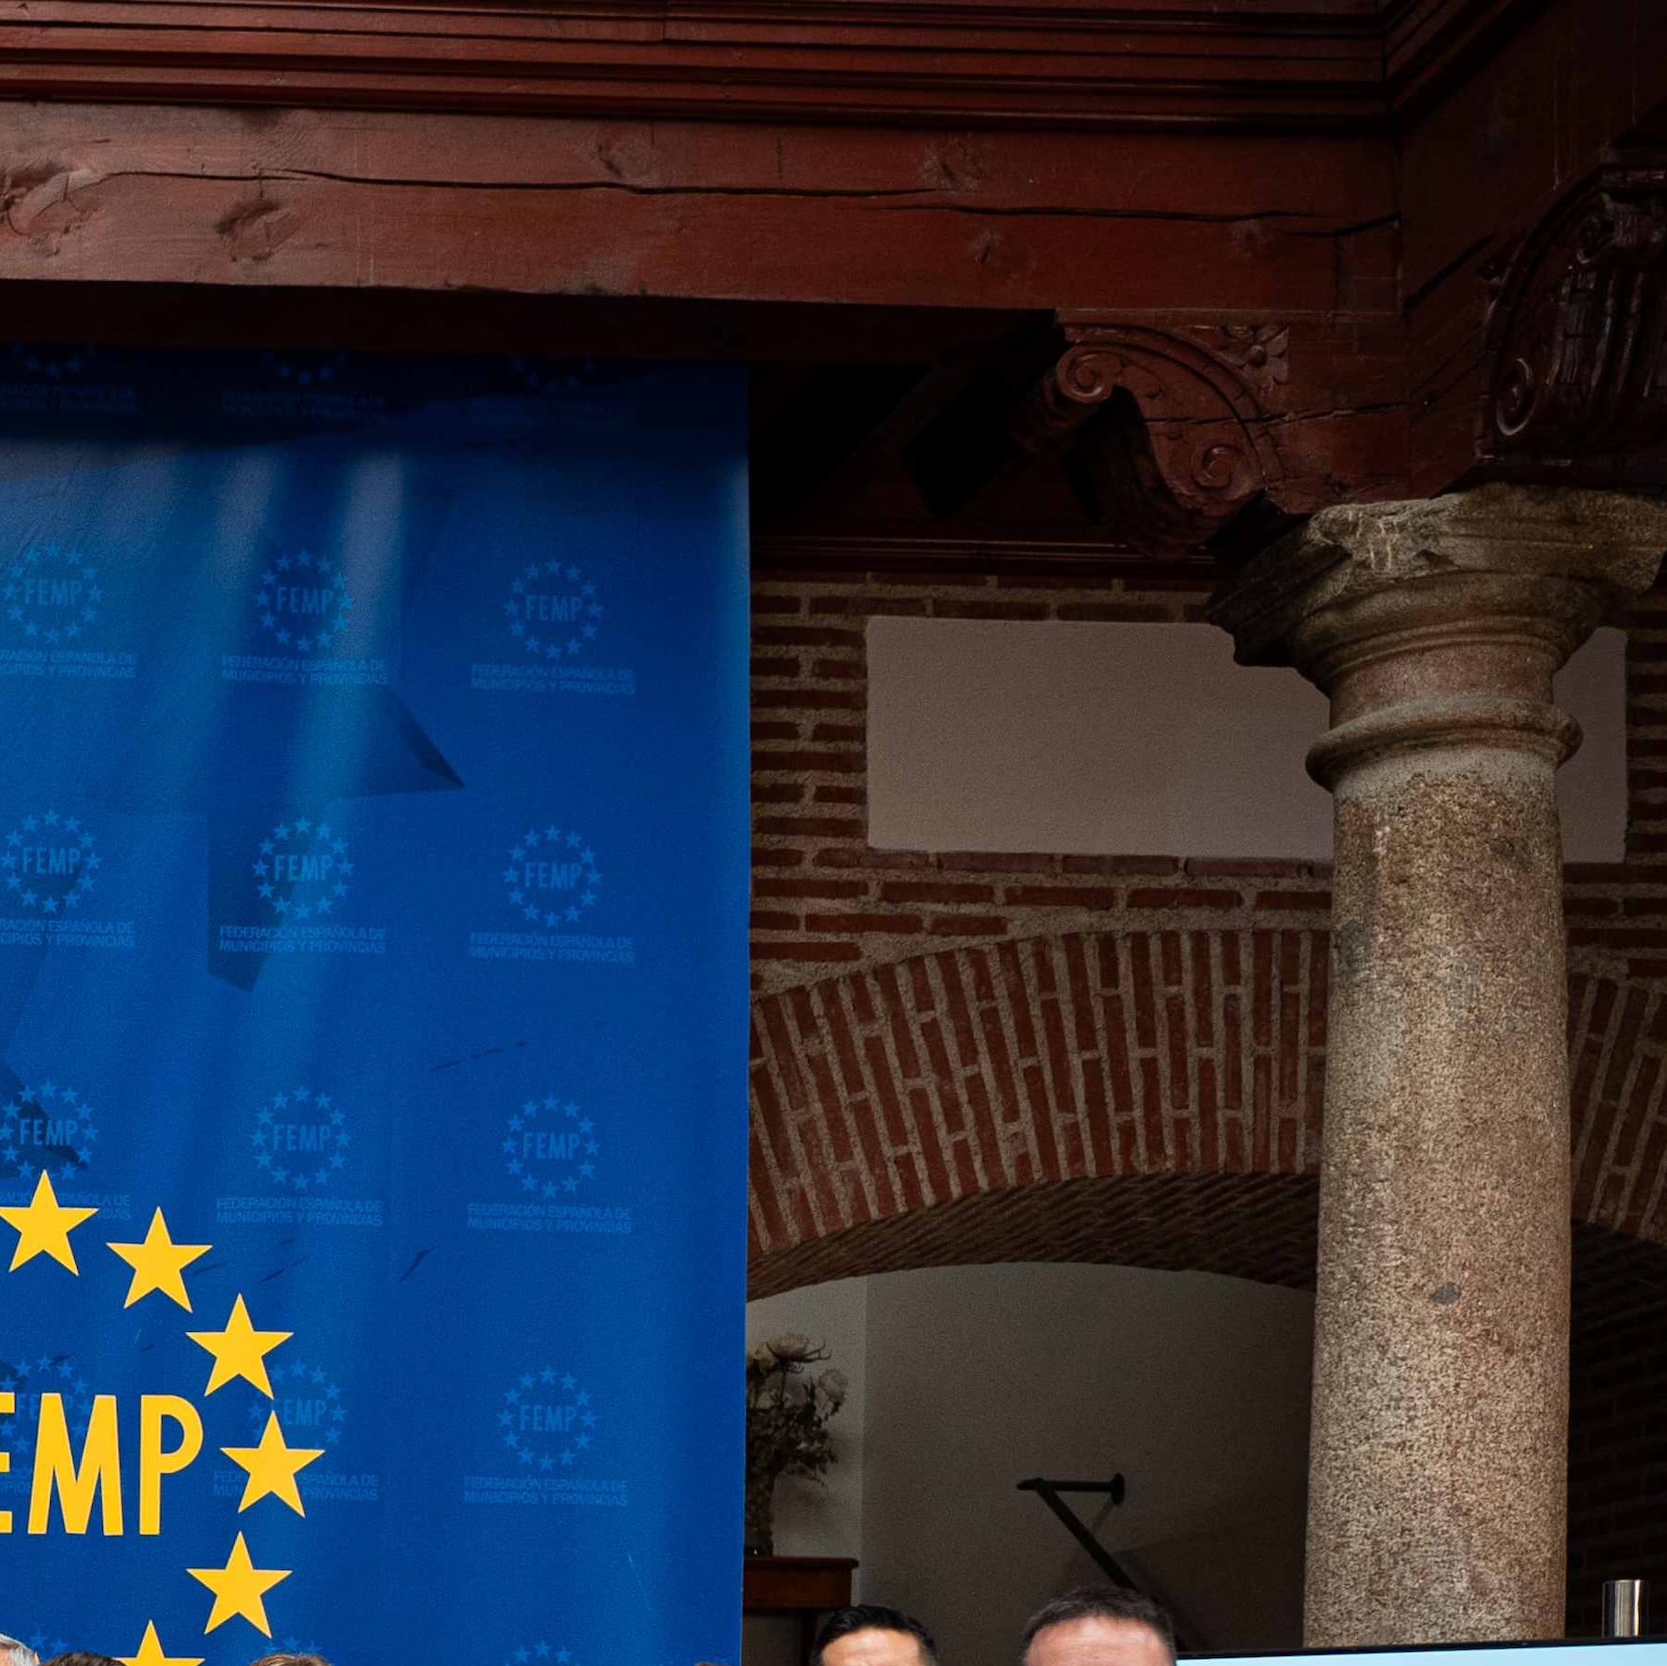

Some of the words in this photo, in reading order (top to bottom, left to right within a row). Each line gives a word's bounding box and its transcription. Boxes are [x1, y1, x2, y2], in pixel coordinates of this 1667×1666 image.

[22, 848, 81, 874] FEMP
[275, 855, 333, 882] FEMP
[524, 862, 581, 890] FEMP
[19, 1119, 78, 1146] FEMP
[273, 1124, 331, 1151] FEMP
[523, 1132, 580, 1160] FEMP
[520, 1405, 577, 1431] FEMP
